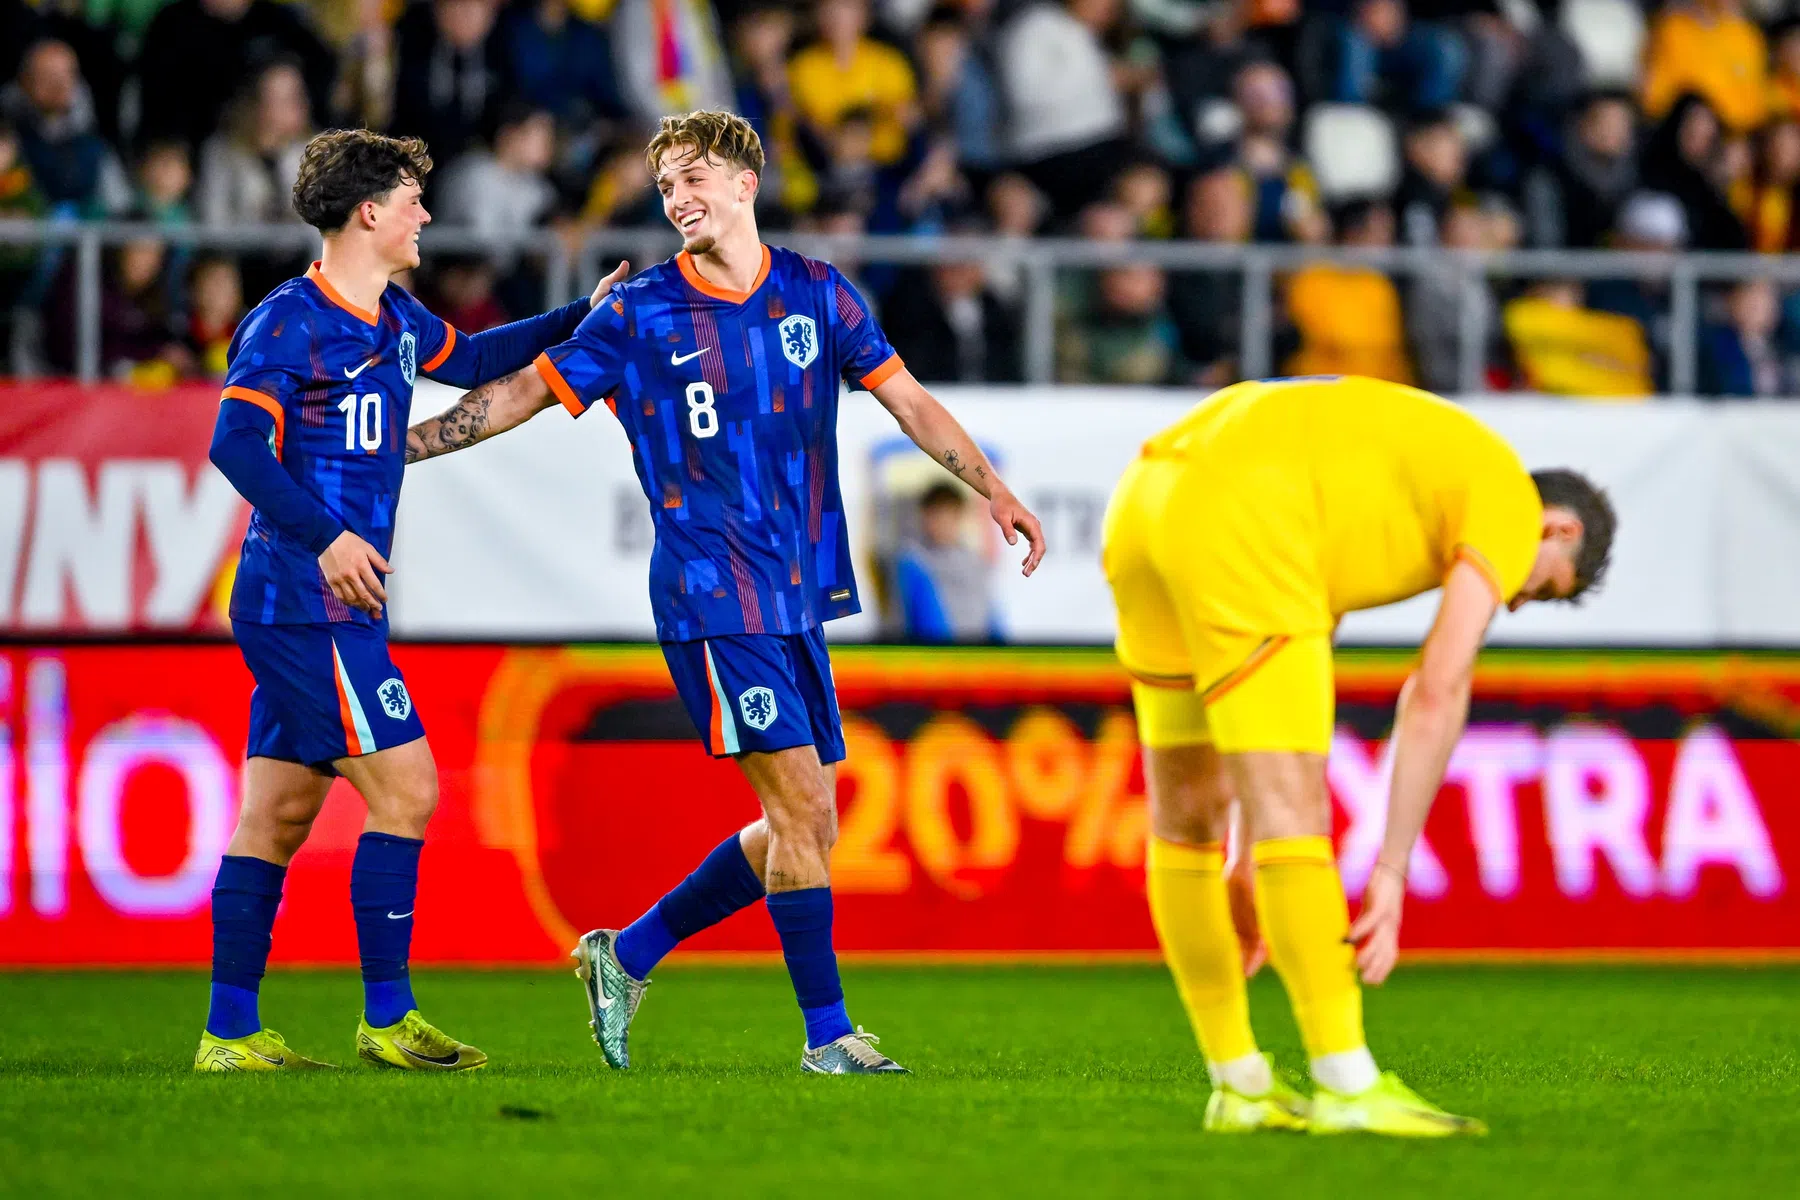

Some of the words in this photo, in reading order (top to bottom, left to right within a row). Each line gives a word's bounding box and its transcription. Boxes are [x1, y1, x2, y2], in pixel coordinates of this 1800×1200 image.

[337, 392, 382, 450] 10
[685, 381, 719, 438] 8
[830, 707, 1153, 896] 20%
